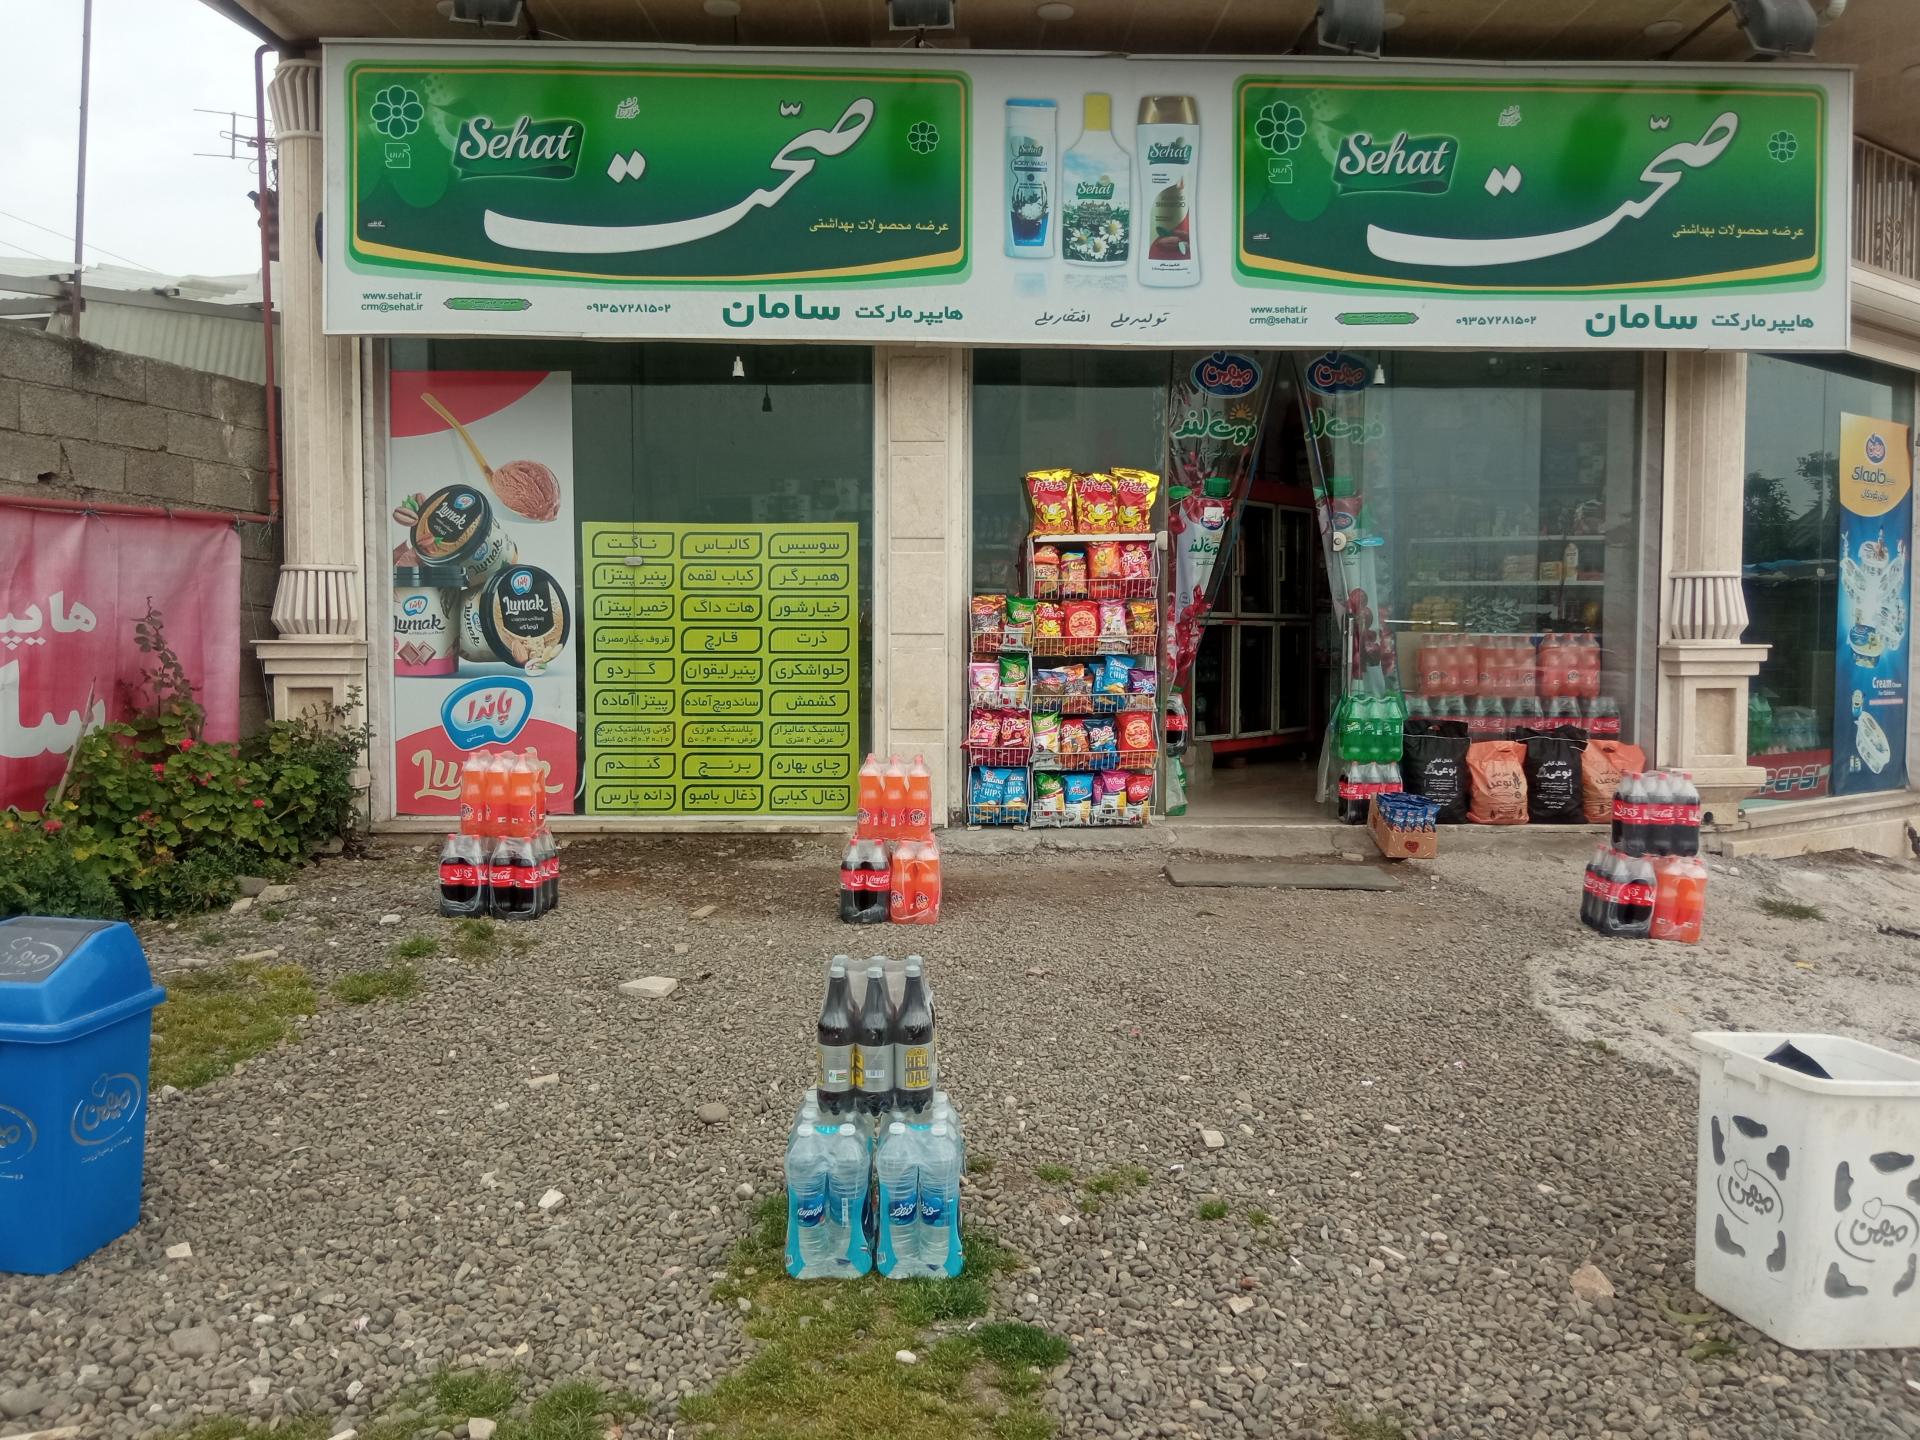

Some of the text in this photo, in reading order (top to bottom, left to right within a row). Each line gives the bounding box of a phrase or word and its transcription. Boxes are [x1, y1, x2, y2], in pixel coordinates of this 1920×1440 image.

[459, 115, 576, 161] Sehat
[1339, 130, 1451, 176] Sehat
[808, 216, 950, 235] عرضه محصولات بهداشتی
[1672, 223, 1805, 241] عرضه محصولات بهداشتی
[362, 291, 423, 301] www.sehat.ir
[360, 301, 424, 313] crm@sehat.ir
[722, 293, 841, 328] سامان
[1250, 305, 1308, 315] www.sehat.ir
[1051, 307, 1091, 326] افتخار
[1129, 311, 1171, 330] تولید
[1249, 315, 1308, 327] crm@sehat.ir
[1585, 304, 1698, 338] سامان
[607, 536, 658, 549] ناگت
[694, 537, 751, 554] کالباس
[778, 541, 840, 554] سوسیس
[602, 568, 667, 587] پنیر پیتزا
[687, 569, 754, 586] کباب لقمه
[778, 567, 840, 586] همبرگر
[502, 593, 549, 616] Lumak
[599, 600, 669, 618] خمیر پیتزا
[693, 599, 755, 614] هات داگ
[775, 601, 841, 618] خیارشور
[646, 635, 670, 645] ظروف
[704, 631, 739, 651] قارچ
[796, 631, 828, 648] ذرت
[607, 663, 657, 679] گردو
[685, 663, 757, 681] پنیر لیقوان
[601, 692, 668, 712] پیتزا آماده
[685, 694, 759, 713] ساندویچ آماده
[785, 695, 837, 711] کشمش
[605, 757, 661, 774] گندم
[698, 760, 752, 777] برنج
[776, 759, 841, 776] چای بهاره
[601, 789, 673, 804] دانه پارس
[688, 789, 757, 805] ذغال بامبو
[773, 789, 845, 805] ذغال کبابی
[1728, 1175, 1775, 1216] میهن
[1850, 1218, 1909, 1247] میهن
